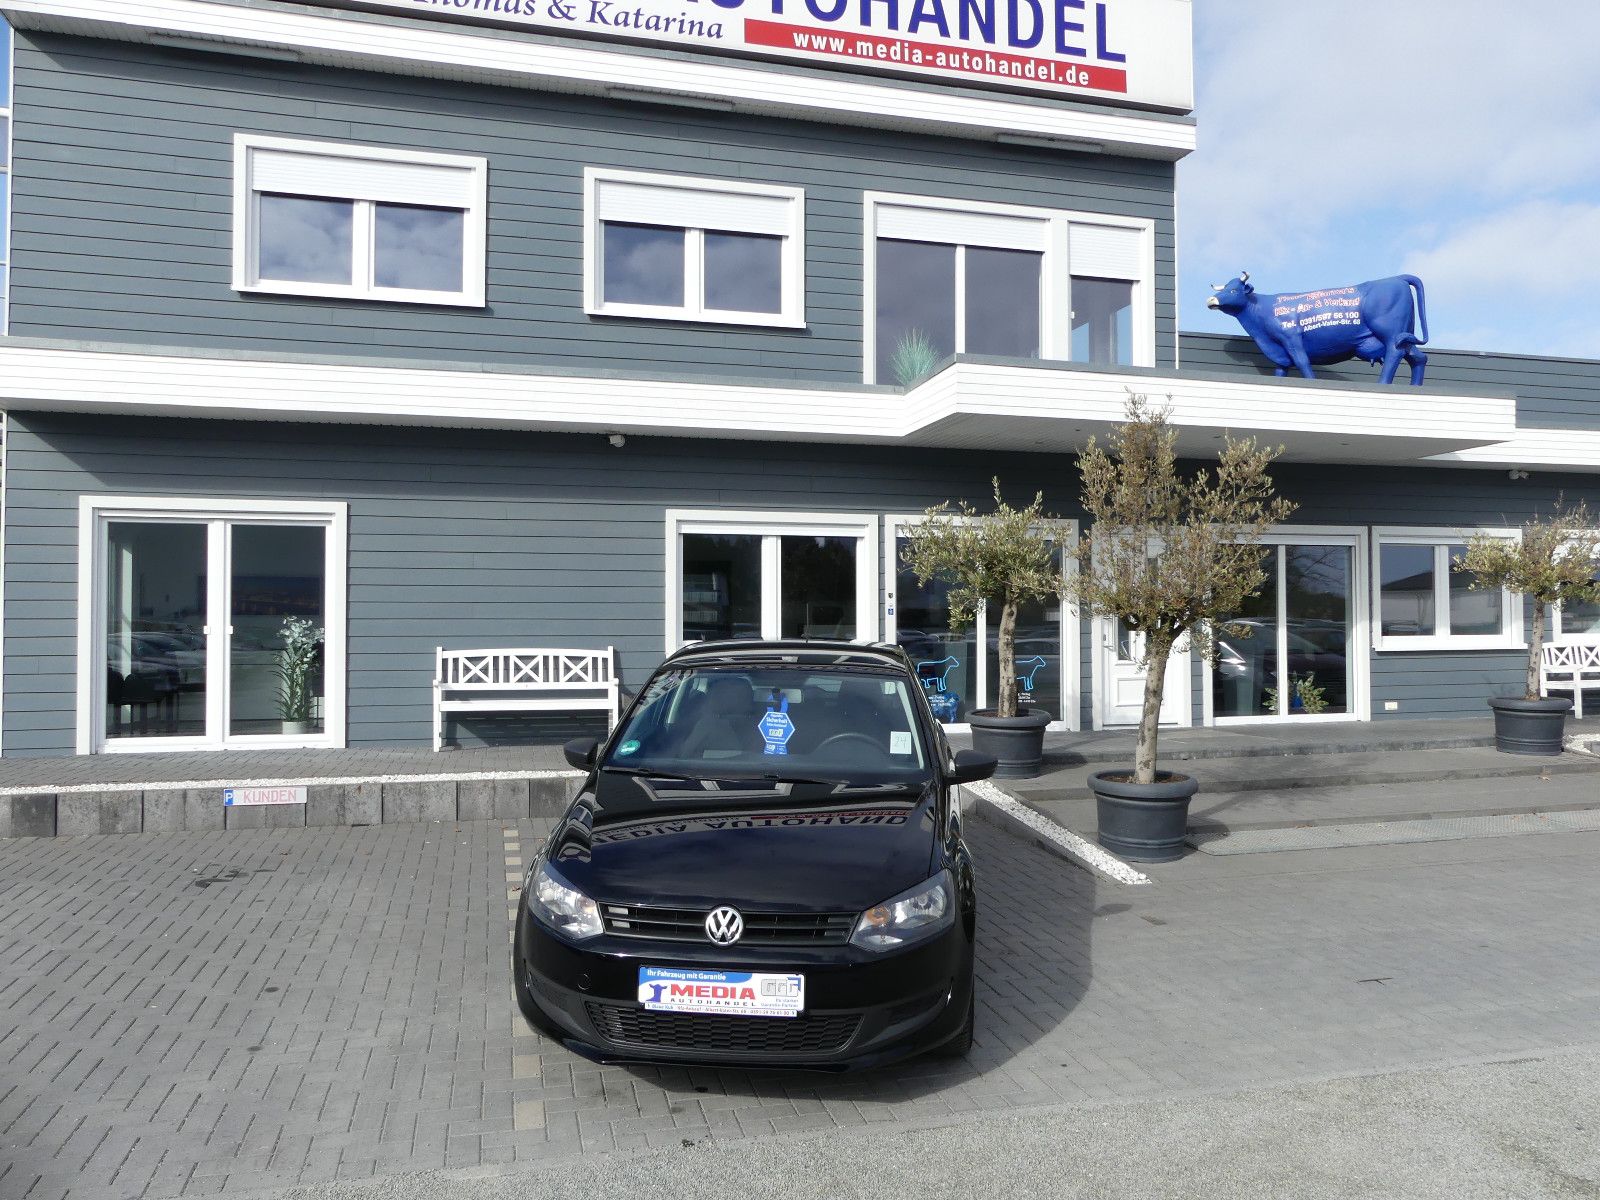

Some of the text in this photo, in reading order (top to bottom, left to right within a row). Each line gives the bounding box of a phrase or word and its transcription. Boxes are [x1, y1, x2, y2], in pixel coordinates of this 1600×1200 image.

[546, 0, 578, 21] &
[585, 0, 724, 39] Katarina
[687, 0, 1126, 63] HANDEL
[792, 31, 1090, 86] www.media-autohandel.de
[243, 789, 297, 803] KUNDEN
[657, 970, 686, 980] Fahrzeug
[670, 983, 756, 1000] MEDIA
[670, 998, 757, 1007] AUTOHANDEL
